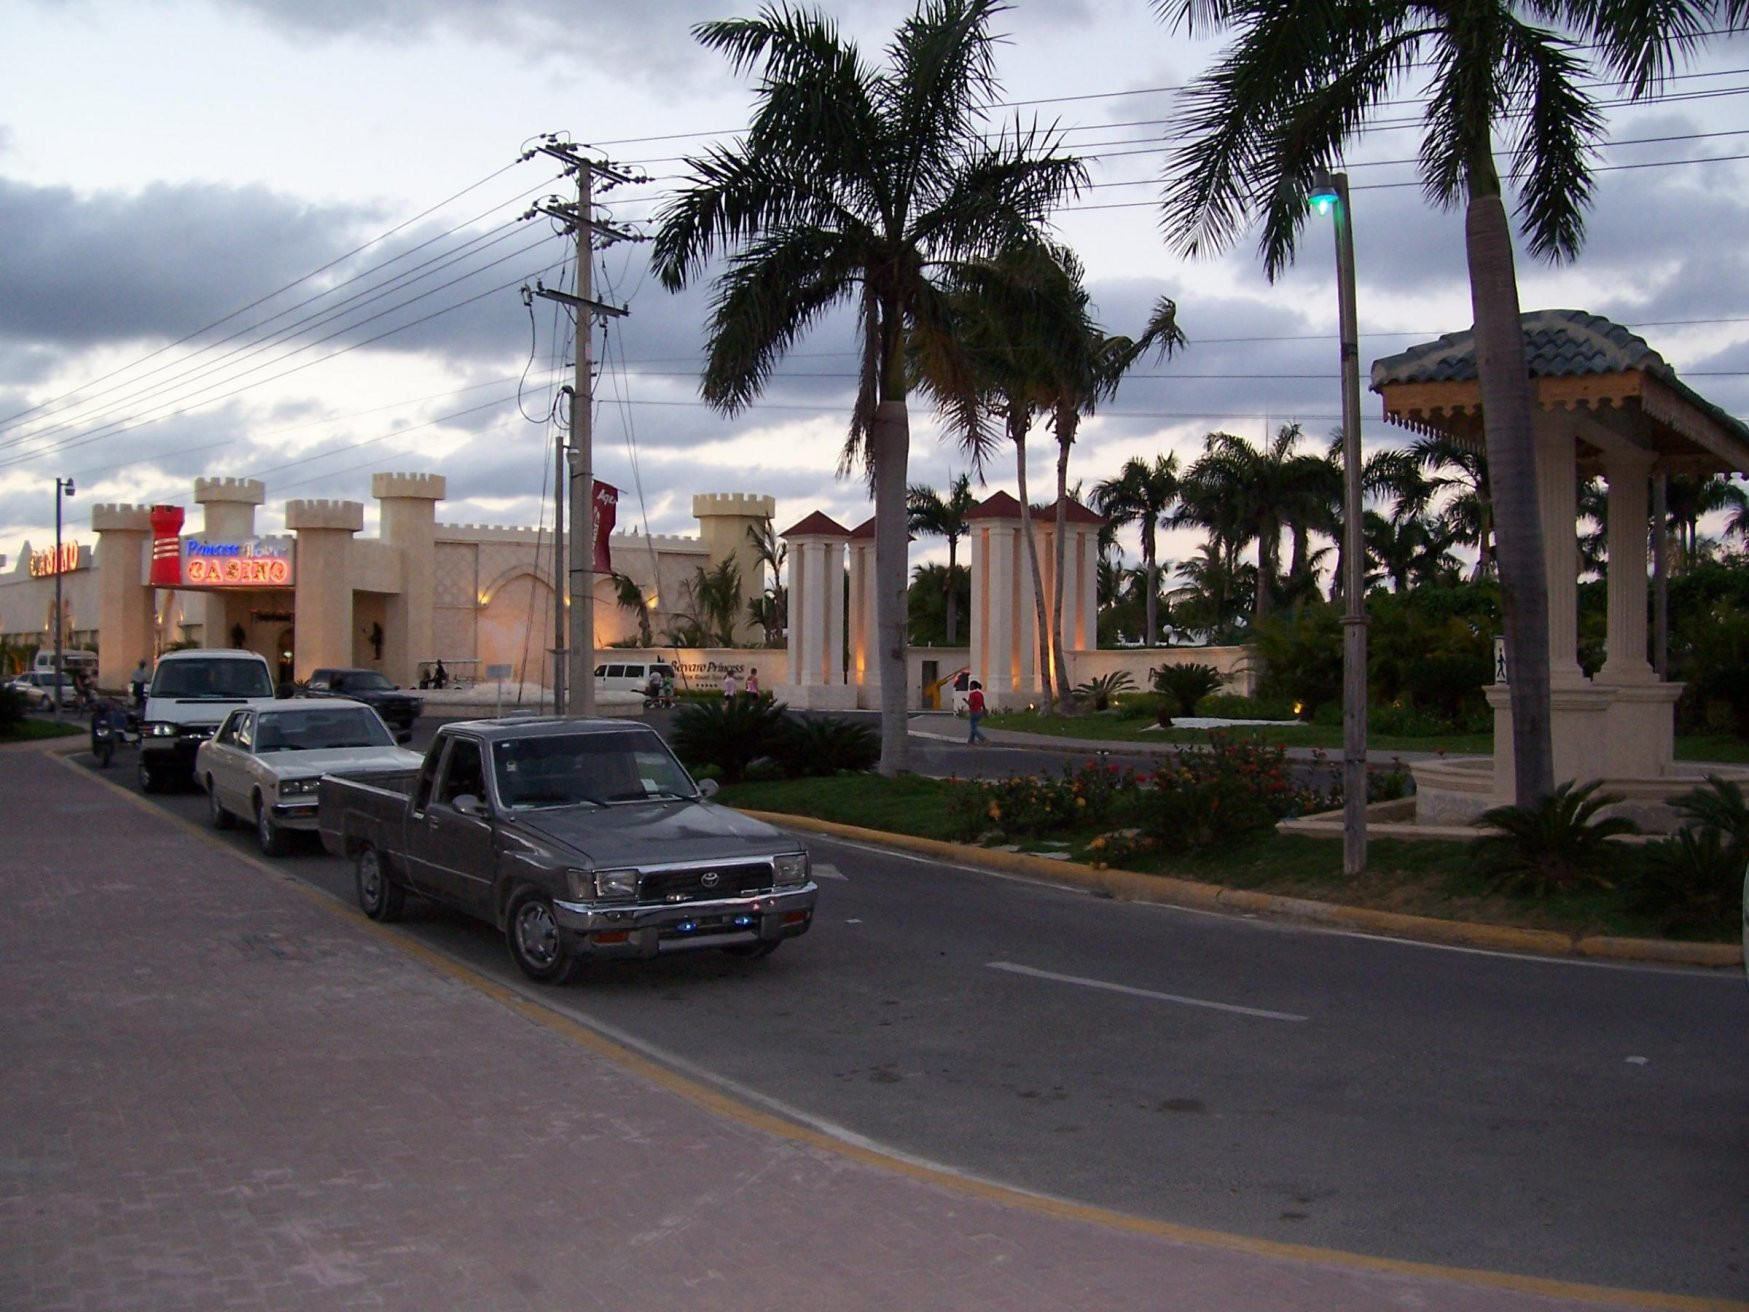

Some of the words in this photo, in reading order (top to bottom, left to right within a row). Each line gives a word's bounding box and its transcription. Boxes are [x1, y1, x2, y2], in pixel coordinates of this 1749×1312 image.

[187, 538, 239, 556] Princess
[30, 540, 79, 577] CASINO
[187, 558, 288, 583] CASINO
[707, 661, 745, 673] Princess
